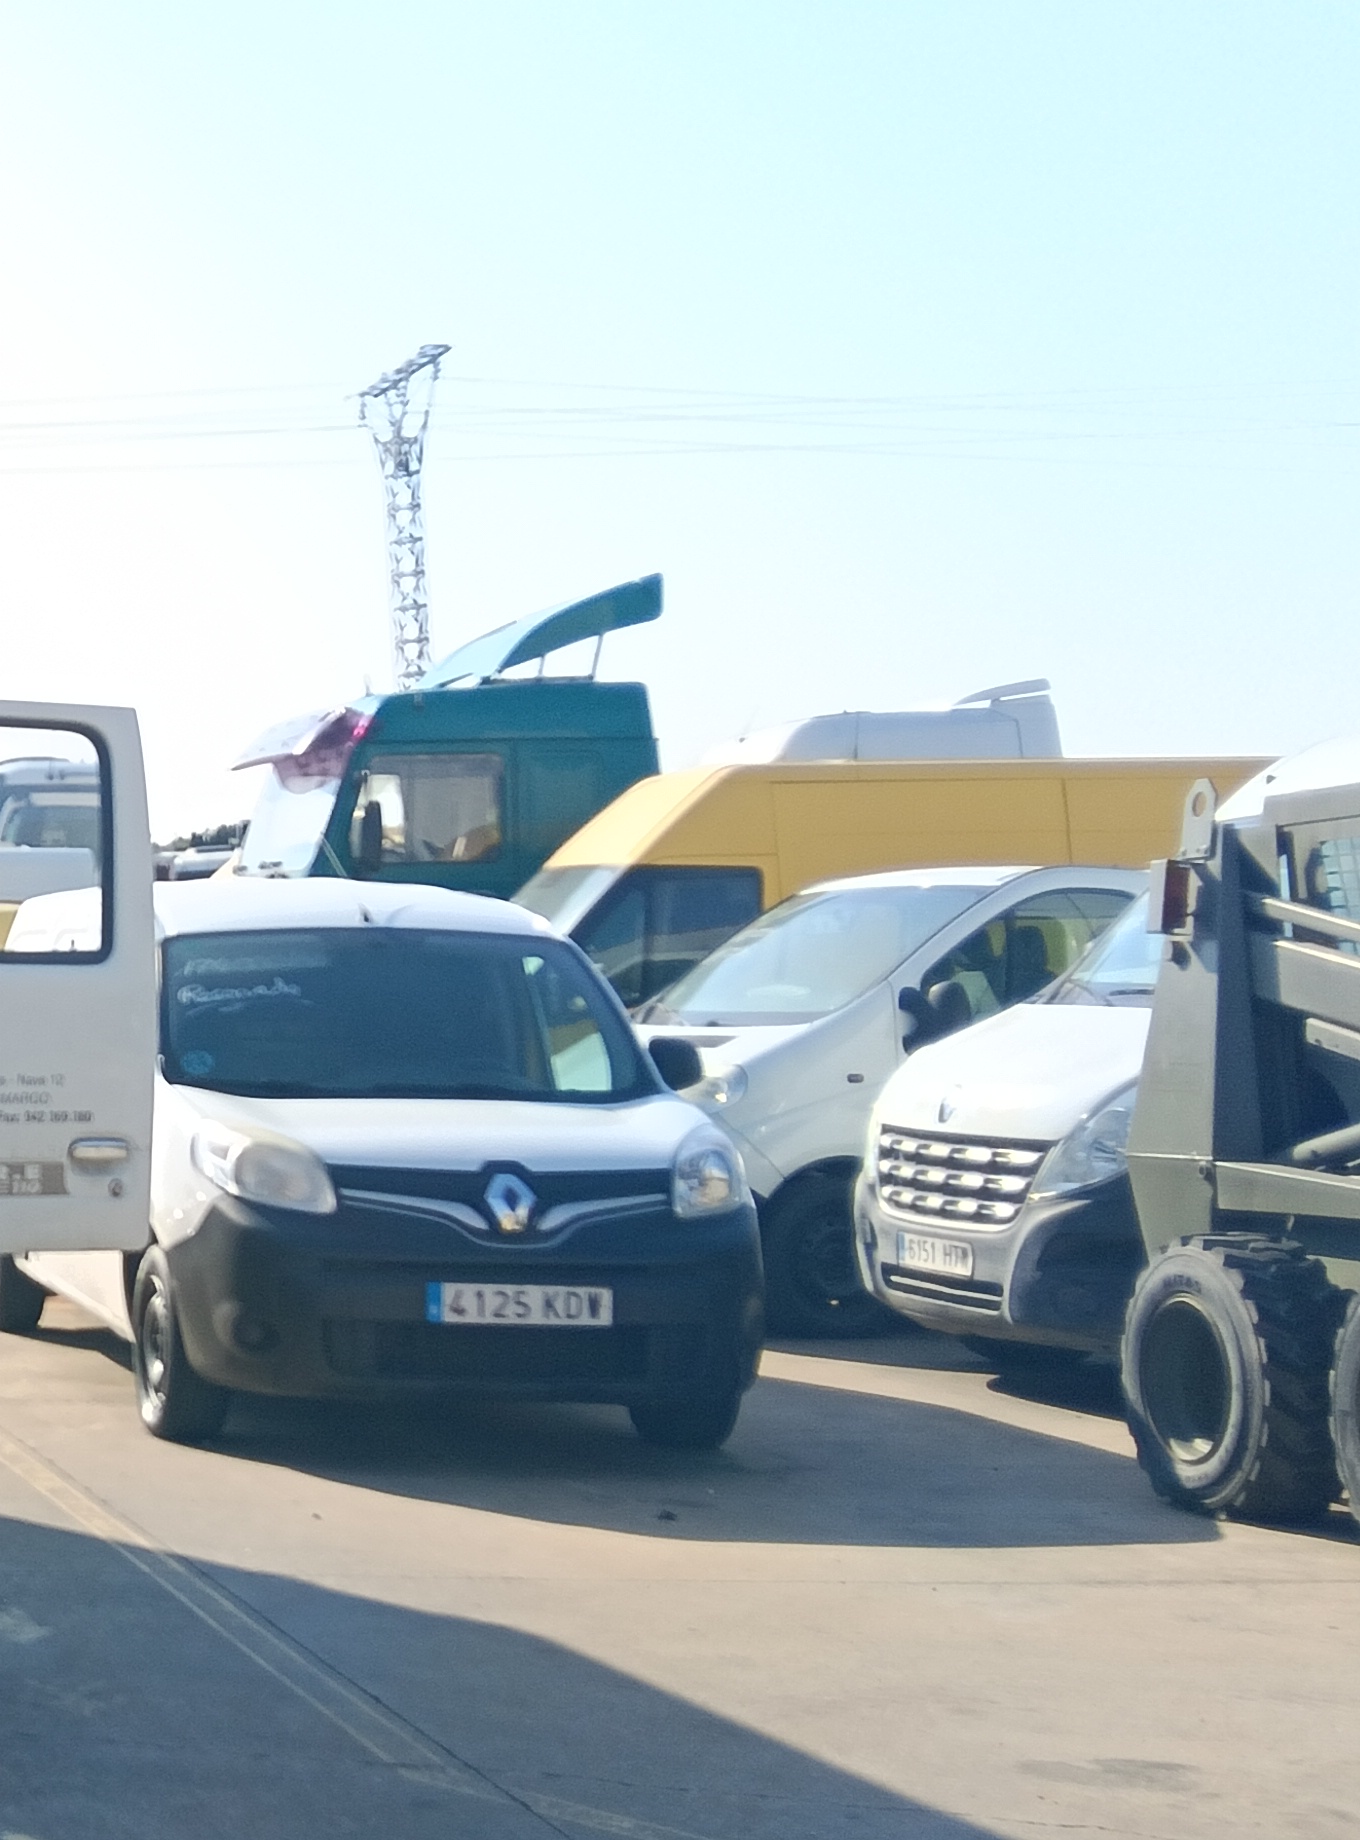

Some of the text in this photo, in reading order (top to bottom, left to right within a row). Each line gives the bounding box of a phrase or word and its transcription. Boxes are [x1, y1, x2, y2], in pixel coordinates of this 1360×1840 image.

[908, 1238, 936, 1265] 6151
[448, 1289, 603, 1321] 4125 KDW
